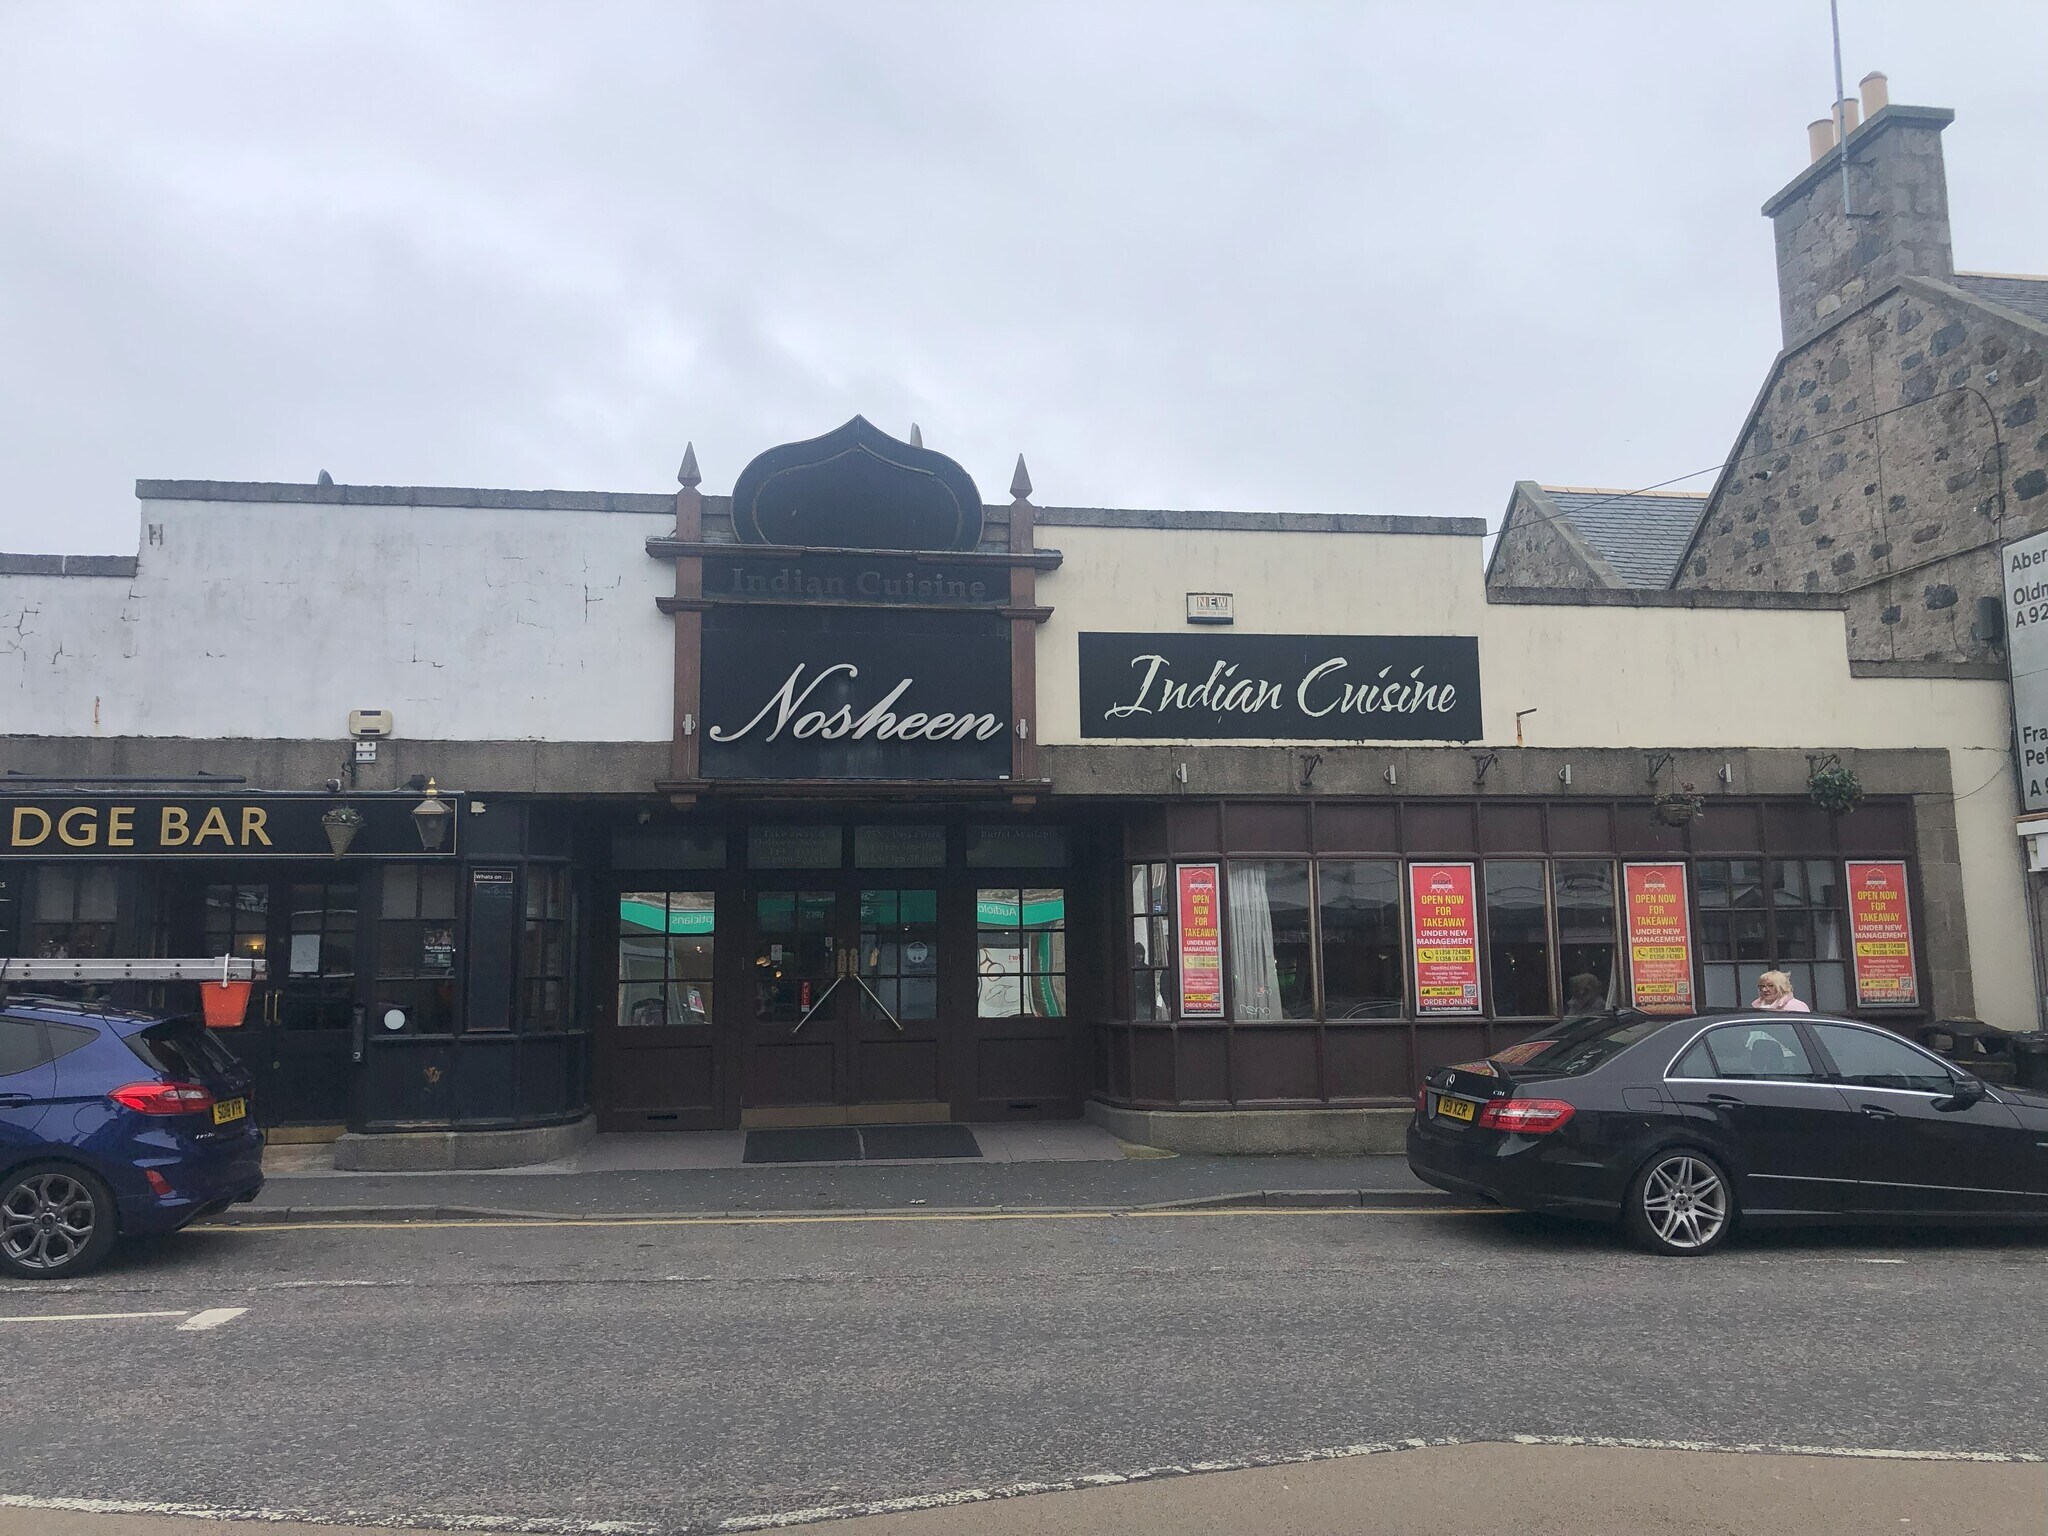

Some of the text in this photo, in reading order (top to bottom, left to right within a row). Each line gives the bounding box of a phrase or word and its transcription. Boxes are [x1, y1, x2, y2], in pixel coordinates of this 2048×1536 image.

[2011, 549, 2048, 573] Aber
[732, 568, 986, 598] Indian Cuisine
[1197, 597, 1228, 607] NEW
[1104, 655, 1456, 721] Indian Cuisine
[709, 663, 1004, 743] Nosheen
[11, 806, 273, 847] DGE BAR
[1192, 895, 1209, 904] OPEN
[1421, 895, 1464, 904] OPEN NOW
[1635, 894, 1676, 903] OPEN NOW
[1857, 891, 1897, 900] OPEN NOW
[1194, 906, 1209, 915] NOW
[1436, 906, 1451, 915] FOR
[1649, 905, 1664, 914] FOR
[1870, 902, 1886, 911] FOR
[1195, 917, 1208, 926] FOR
[1637, 916, 1678, 926] TAKEAWAY
[1859, 913, 1900, 922] TAKEAWAY
[1422, 918, 1466, 927] TAKEAWAY
[1184, 928, 1218, 937] TAKEAWAY
